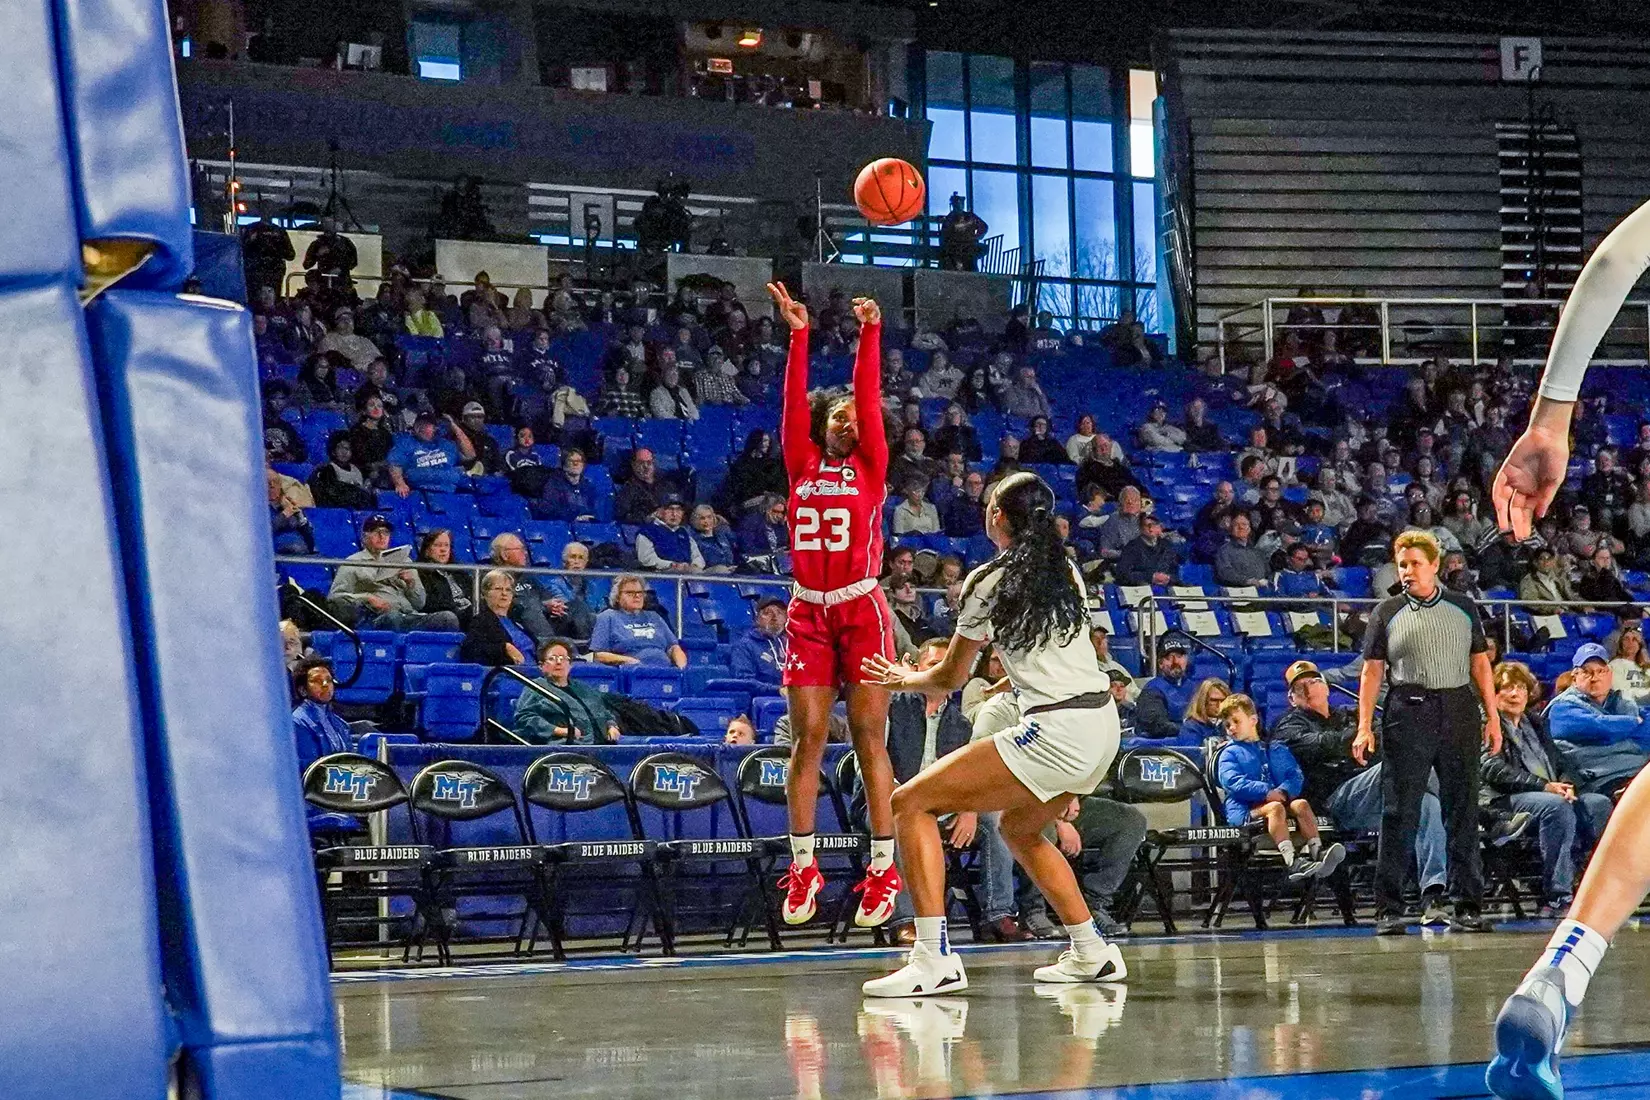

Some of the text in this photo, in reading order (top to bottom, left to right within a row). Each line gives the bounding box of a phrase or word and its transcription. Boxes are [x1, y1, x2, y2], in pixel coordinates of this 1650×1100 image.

[1513, 46, 1529, 71] F
[794, 507, 851, 552] 23
[323, 766, 376, 801] MT
[548, 766, 598, 801] MT
[653, 766, 702, 801] MT
[759, 759, 788, 786] M
[1140, 756, 1183, 789] MT
[432, 774, 483, 808] MT
[823, 836, 859, 848] RAIDERS
[1187, 828, 1240, 840] BLUE RAIDERS
[354, 848, 420, 861] BLUE RAIDERS
[467, 848, 532, 862] BLUE RAIDERS
[581, 842, 645, 857] BLUE RAIDERS
[692, 841, 752, 854] BLUE RAIDERS
